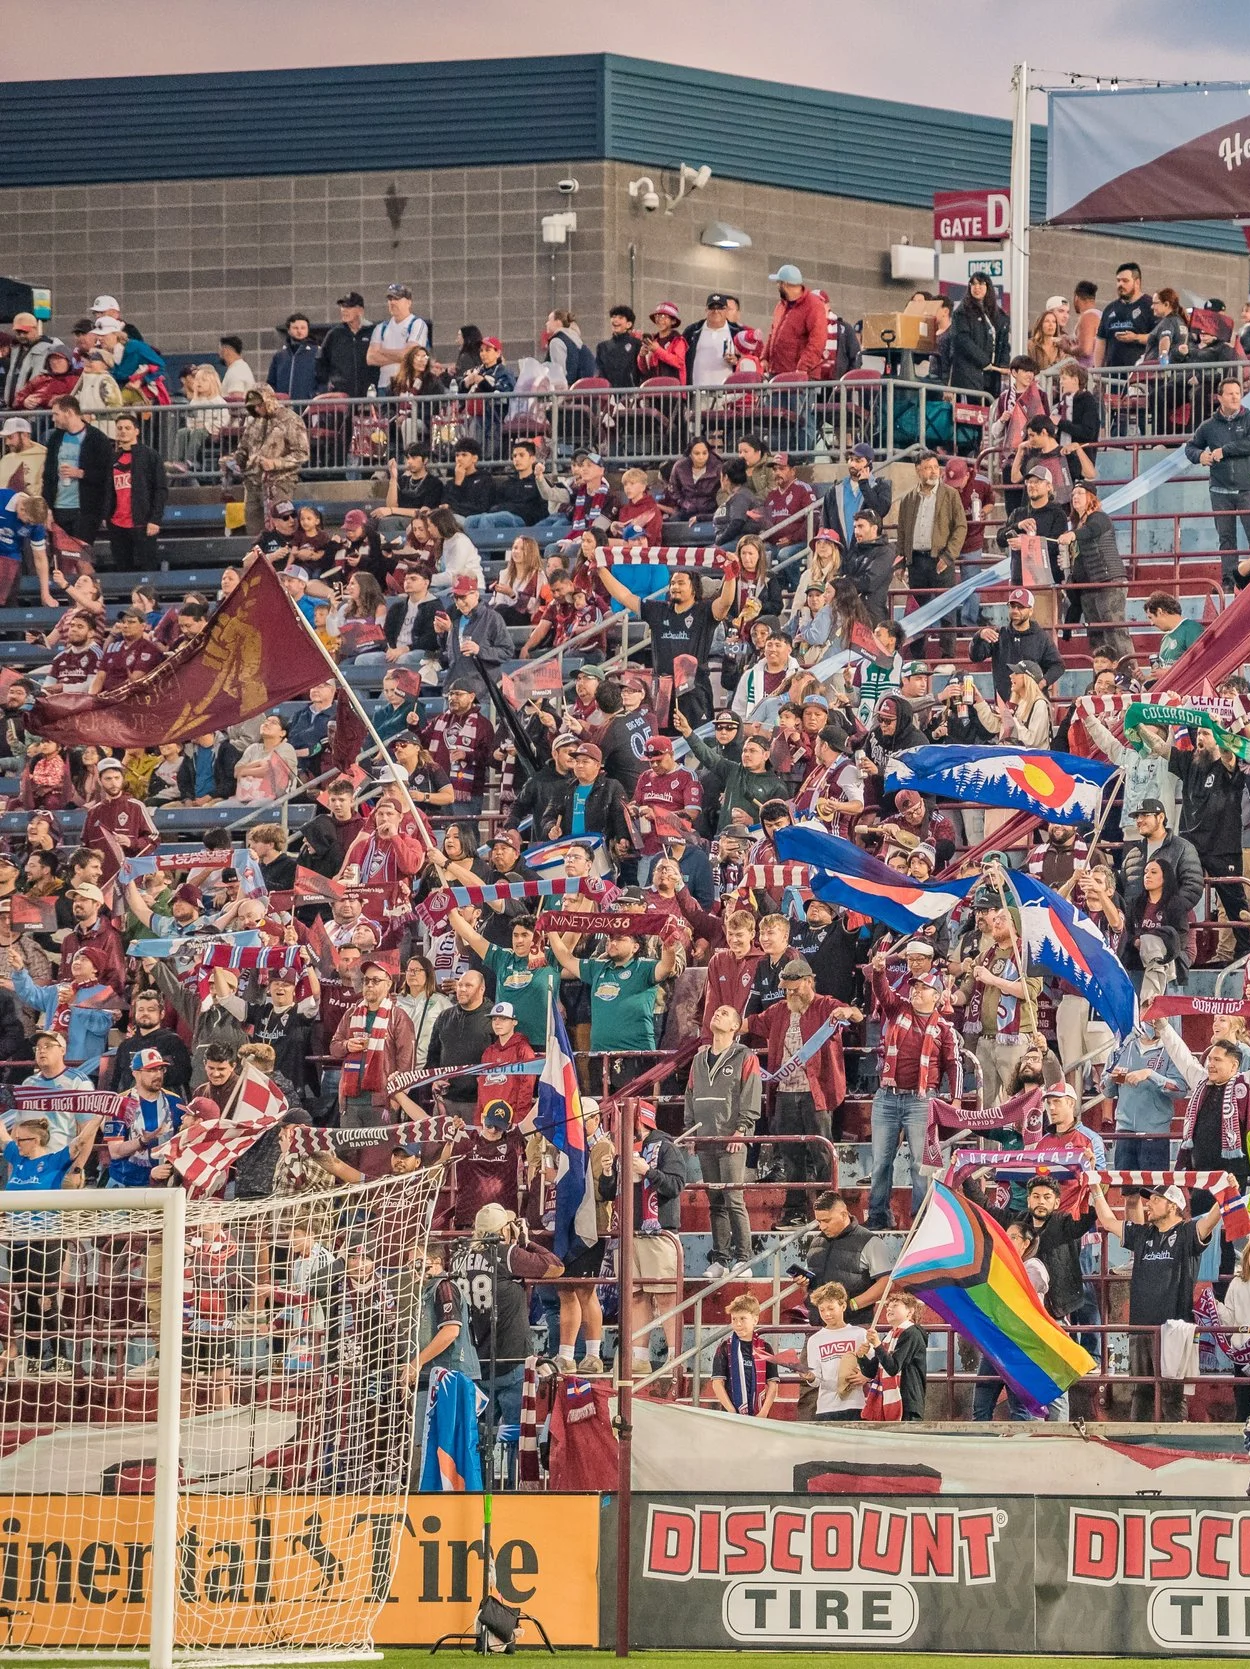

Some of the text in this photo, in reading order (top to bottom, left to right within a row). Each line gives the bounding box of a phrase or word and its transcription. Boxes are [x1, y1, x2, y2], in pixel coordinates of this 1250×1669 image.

[940, 194, 1010, 238] GATE D
[1142, 707, 1203, 726] COLORADO
[1192, 997, 1245, 1015] COLORADO
[956, 1106, 1004, 1122] COLORADO
[967, 1119, 995, 1127] RAPIDS
[336, 1127, 389, 1146] COLORADO
[349, 1139, 380, 1148] RAPIDS
[820, 1342, 856, 1357] NASA
[645, 1505, 1000, 1588] DISCOUNT
[349, 1513, 540, 1604] Tire
[743, 1587, 894, 1632] TIRE
